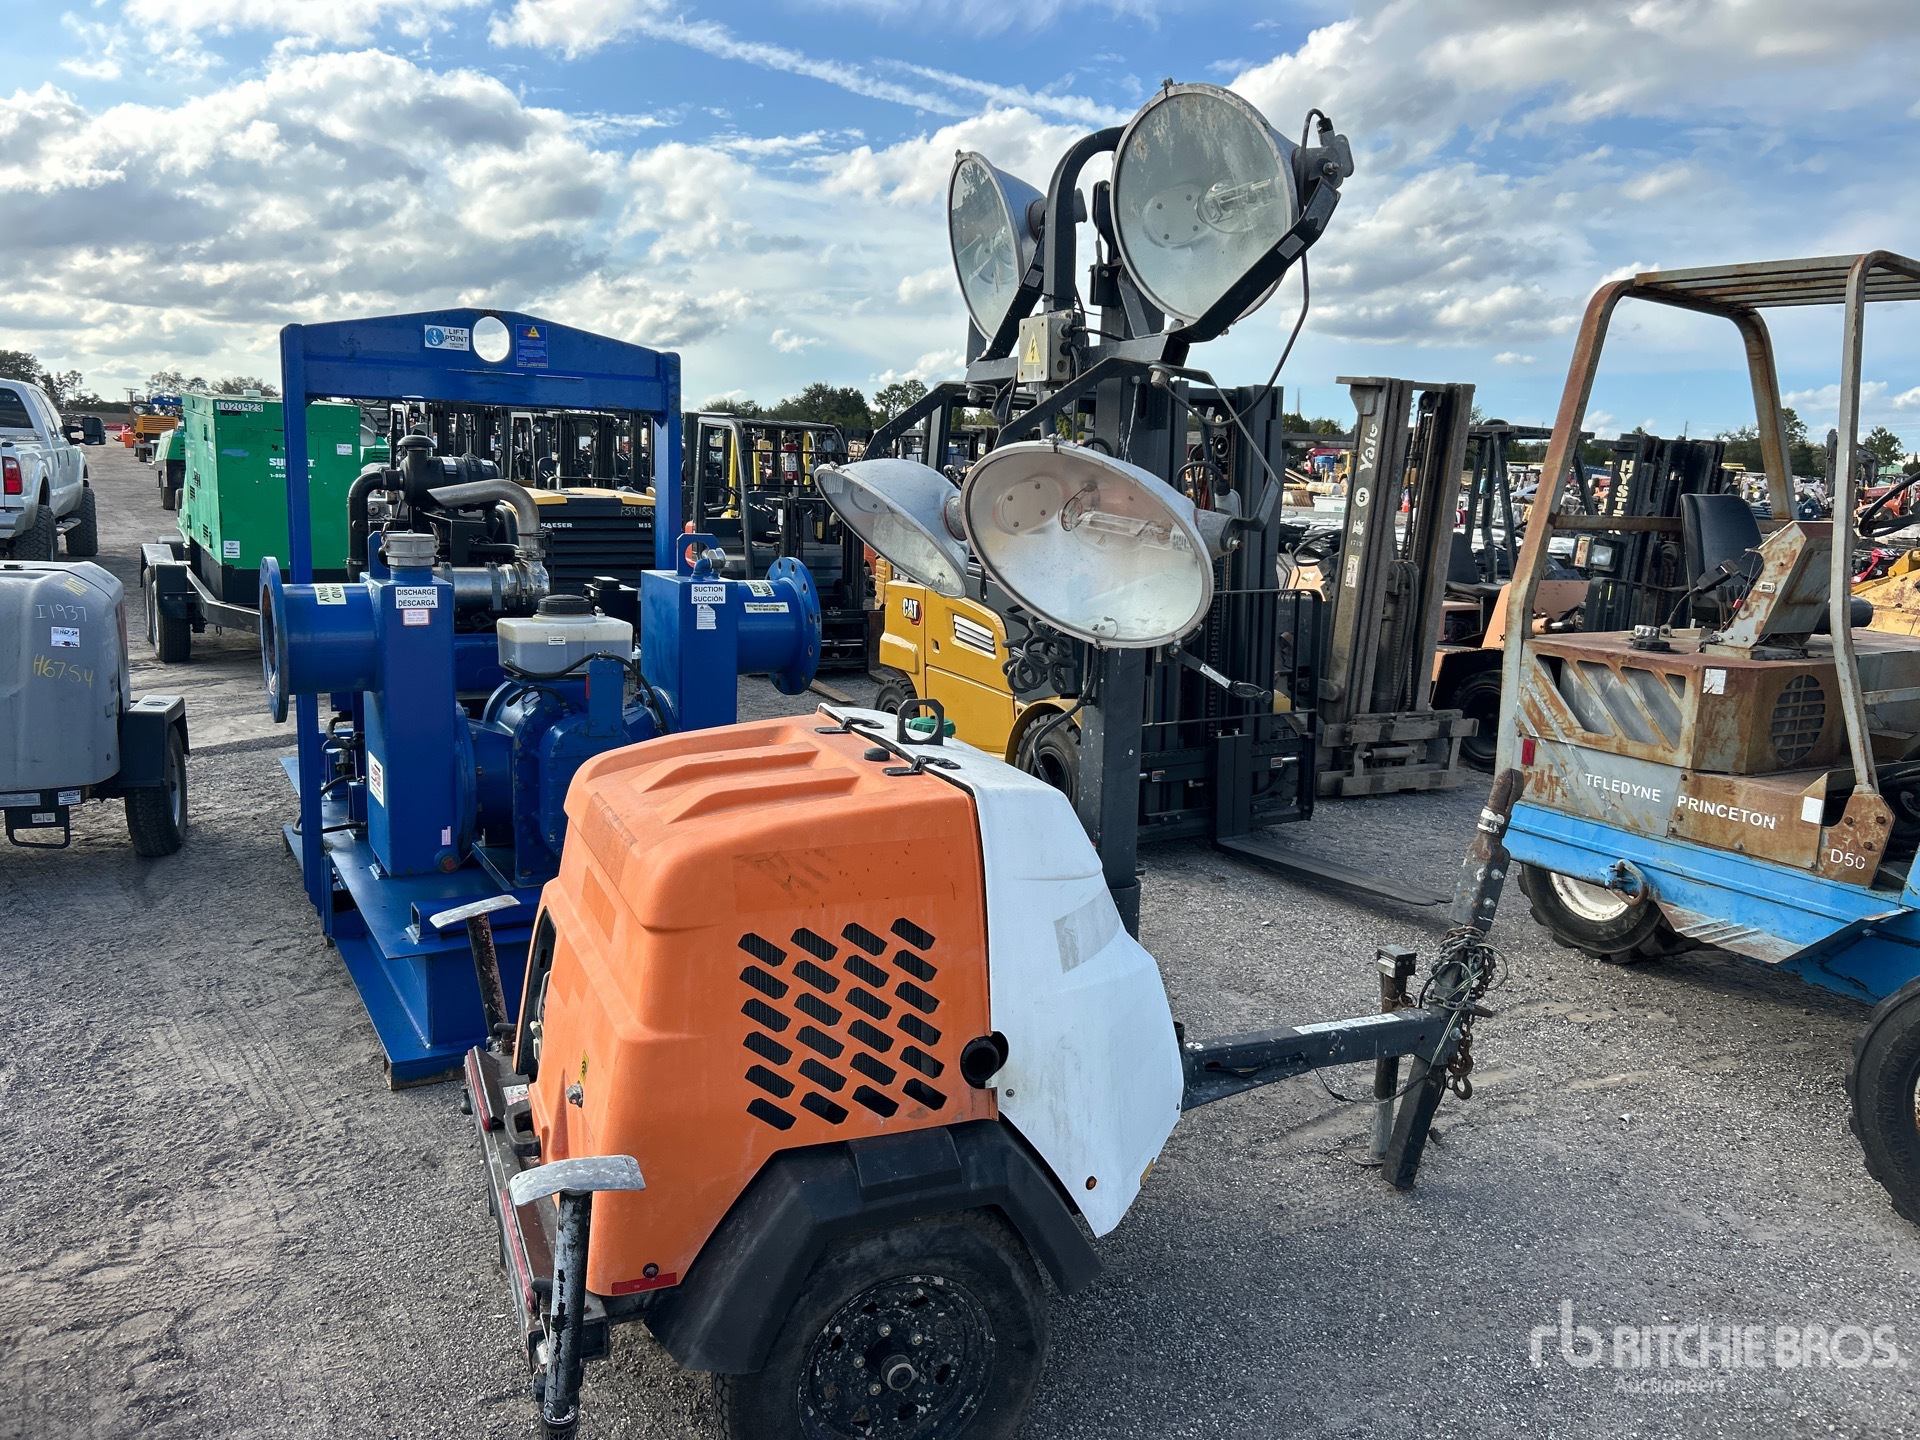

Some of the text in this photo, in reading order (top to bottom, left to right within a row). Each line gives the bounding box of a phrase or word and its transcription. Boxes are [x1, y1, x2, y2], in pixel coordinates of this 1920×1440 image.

[445, 335, 469, 343] POINT
[217, 402, 262, 412] 1020923
[398, 599, 436, 607] DESCARGA
[902, 598, 918, 619] CAT
[1585, 773, 1661, 803] TELEDYNE
[1676, 795, 1776, 831] PRINCETON
